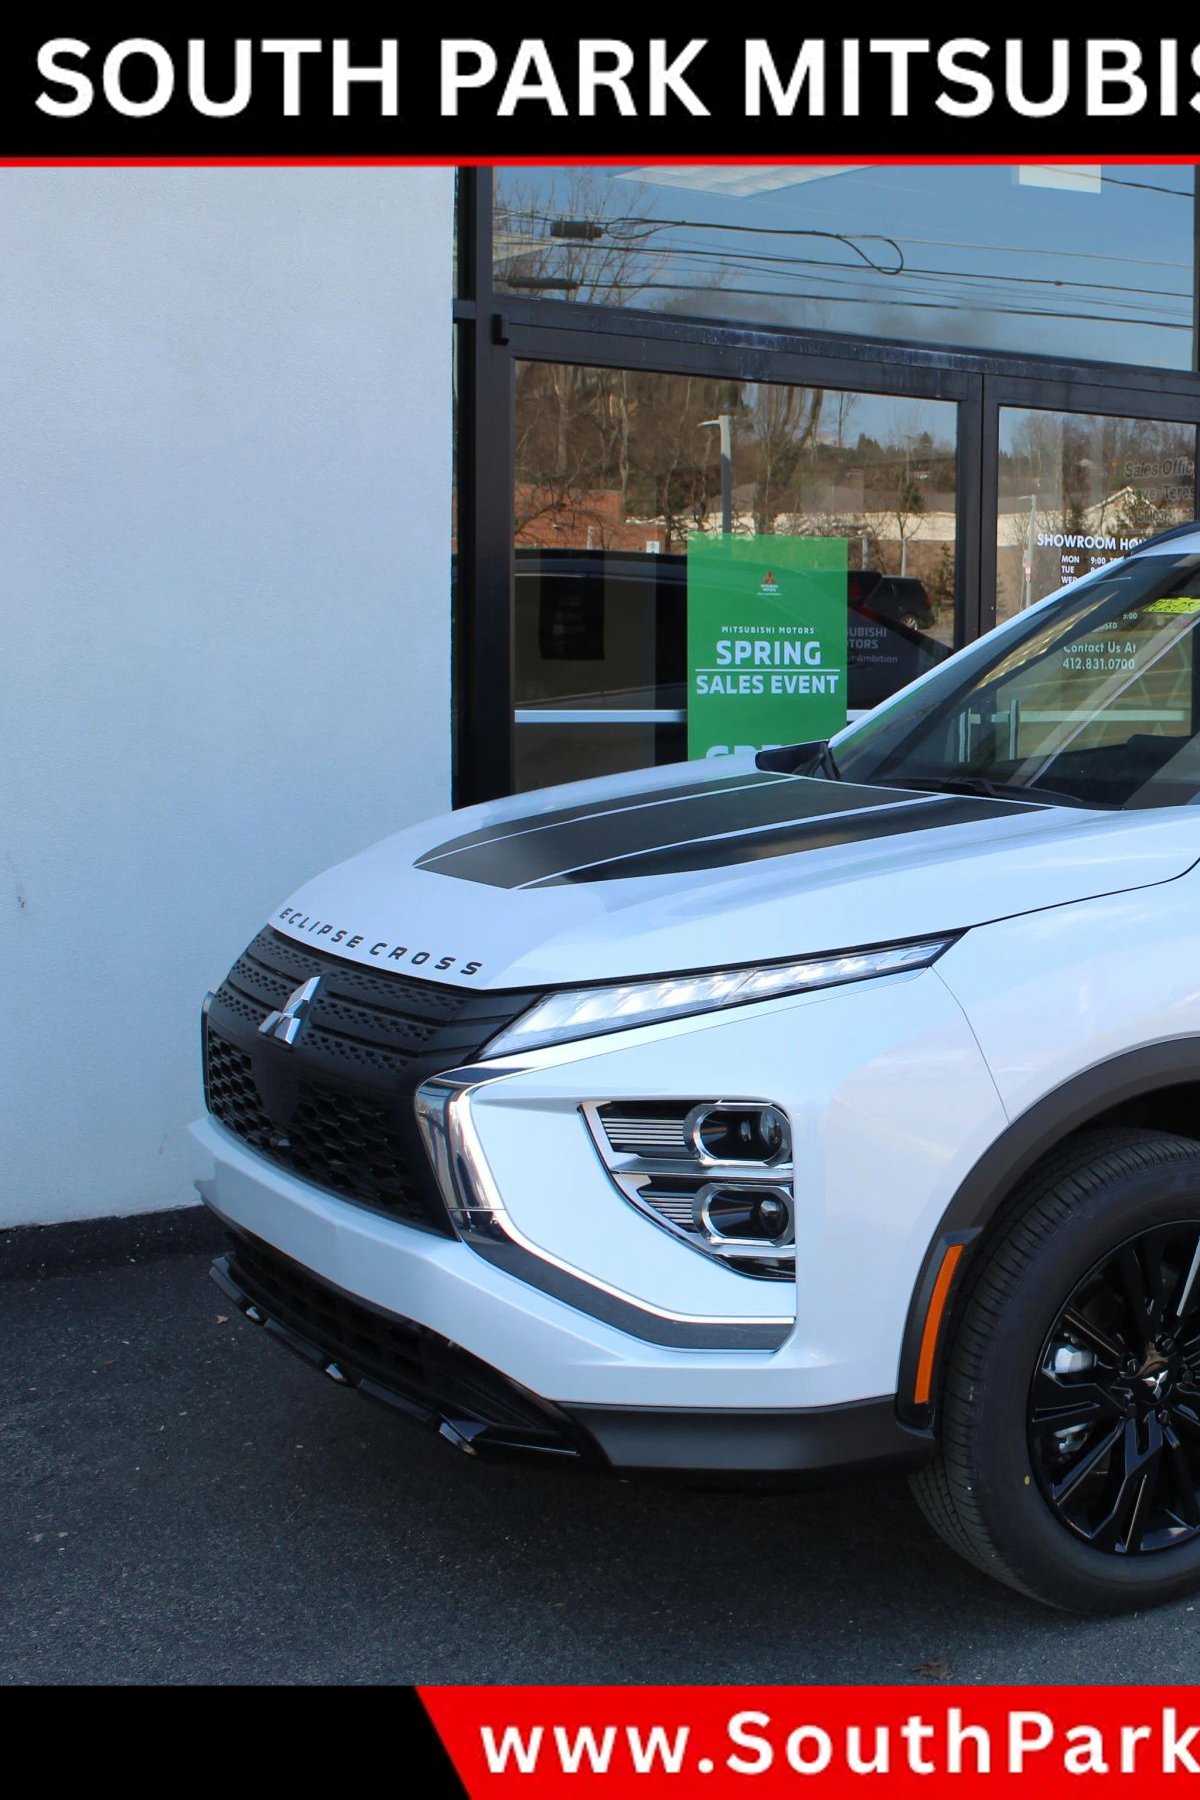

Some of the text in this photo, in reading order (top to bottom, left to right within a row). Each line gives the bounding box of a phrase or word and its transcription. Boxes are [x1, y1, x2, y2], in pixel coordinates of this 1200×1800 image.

[1162, 458, 1195, 476] Offic
[1037, 533, 1116, 550] SHOWROOM
[1061, 555, 1080, 564] MON
[1090, 556, 1106, 565] 9:00
[1061, 565, 1075, 574] TUE
[721, 625, 815, 635] MITSUBISHI MOTORS
[716, 640, 821, 666] SPRING
[1107, 641, 1121, 653] Us
[1124, 642, 1137, 653] At
[1062, 657, 1136, 670] 412.831.0700
[696, 675, 839, 695] SALES EVENT
[279, 907, 483, 976] ECLIPSE CROSS
